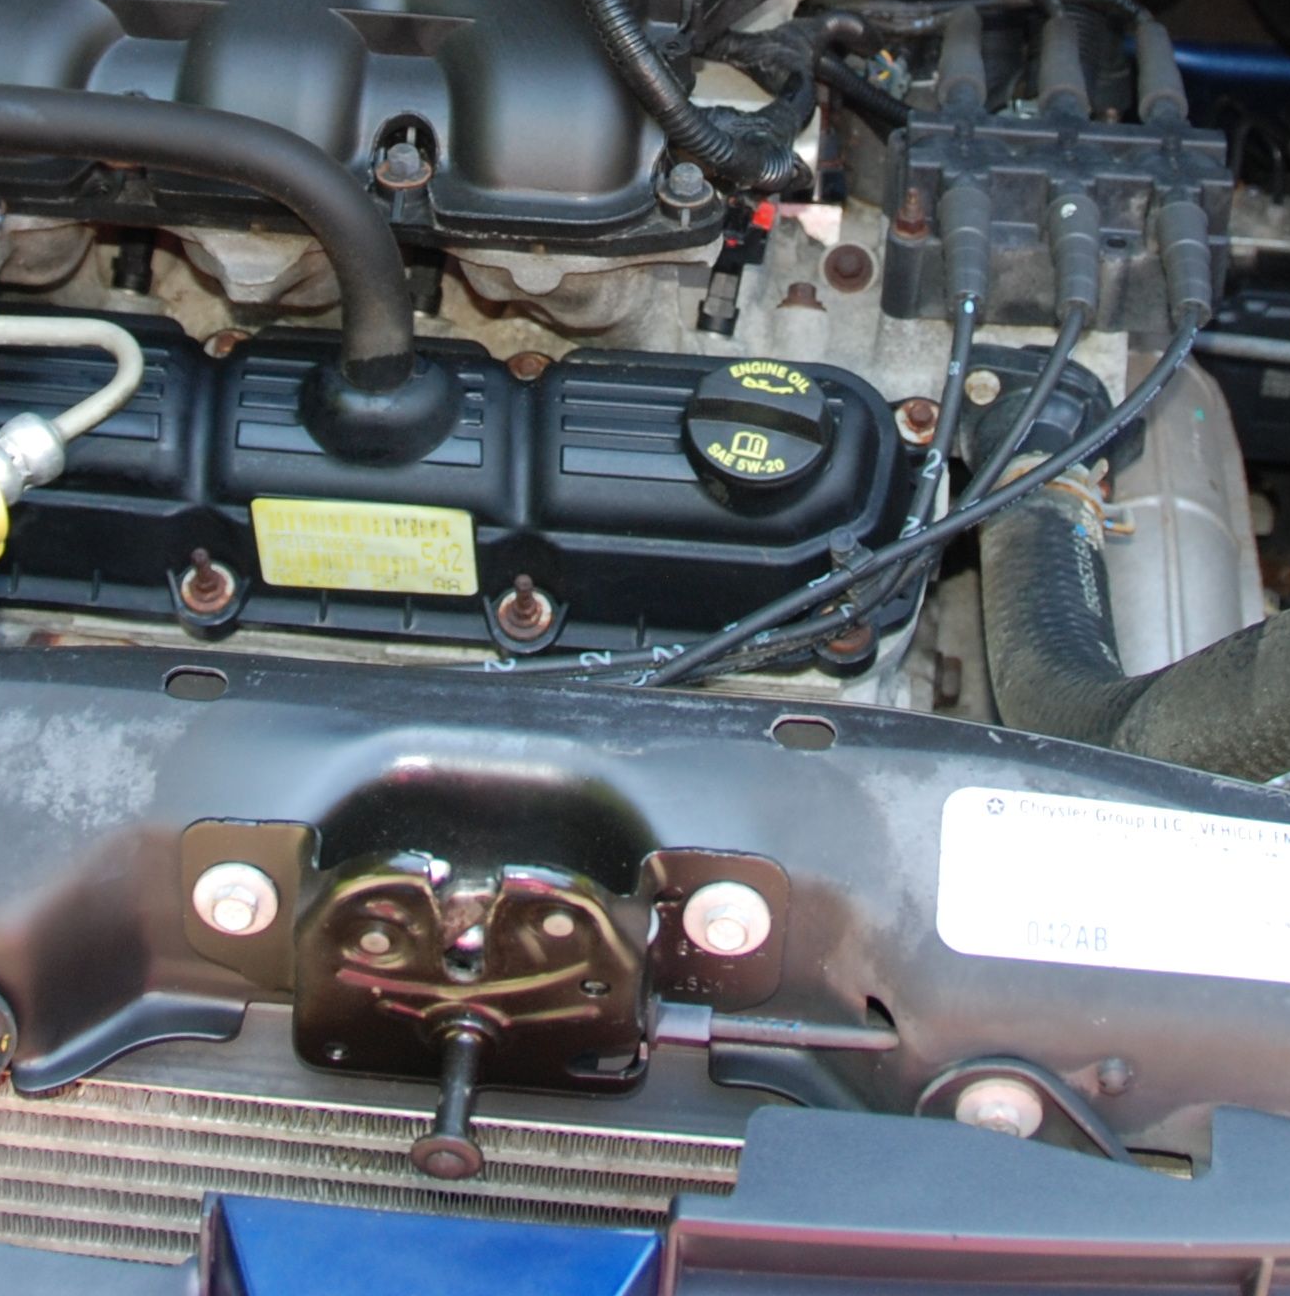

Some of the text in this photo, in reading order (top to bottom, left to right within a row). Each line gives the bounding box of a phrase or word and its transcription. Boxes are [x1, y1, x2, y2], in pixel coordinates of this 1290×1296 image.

[728, 360, 811, 395] ENGINE OIL
[706, 441, 786, 474] SAE 5W-20
[1019, 799, 1088, 819] Chrysler
[1095, 808, 1145, 830] Group
[1199, 822, 1264, 842] VEHICLE
